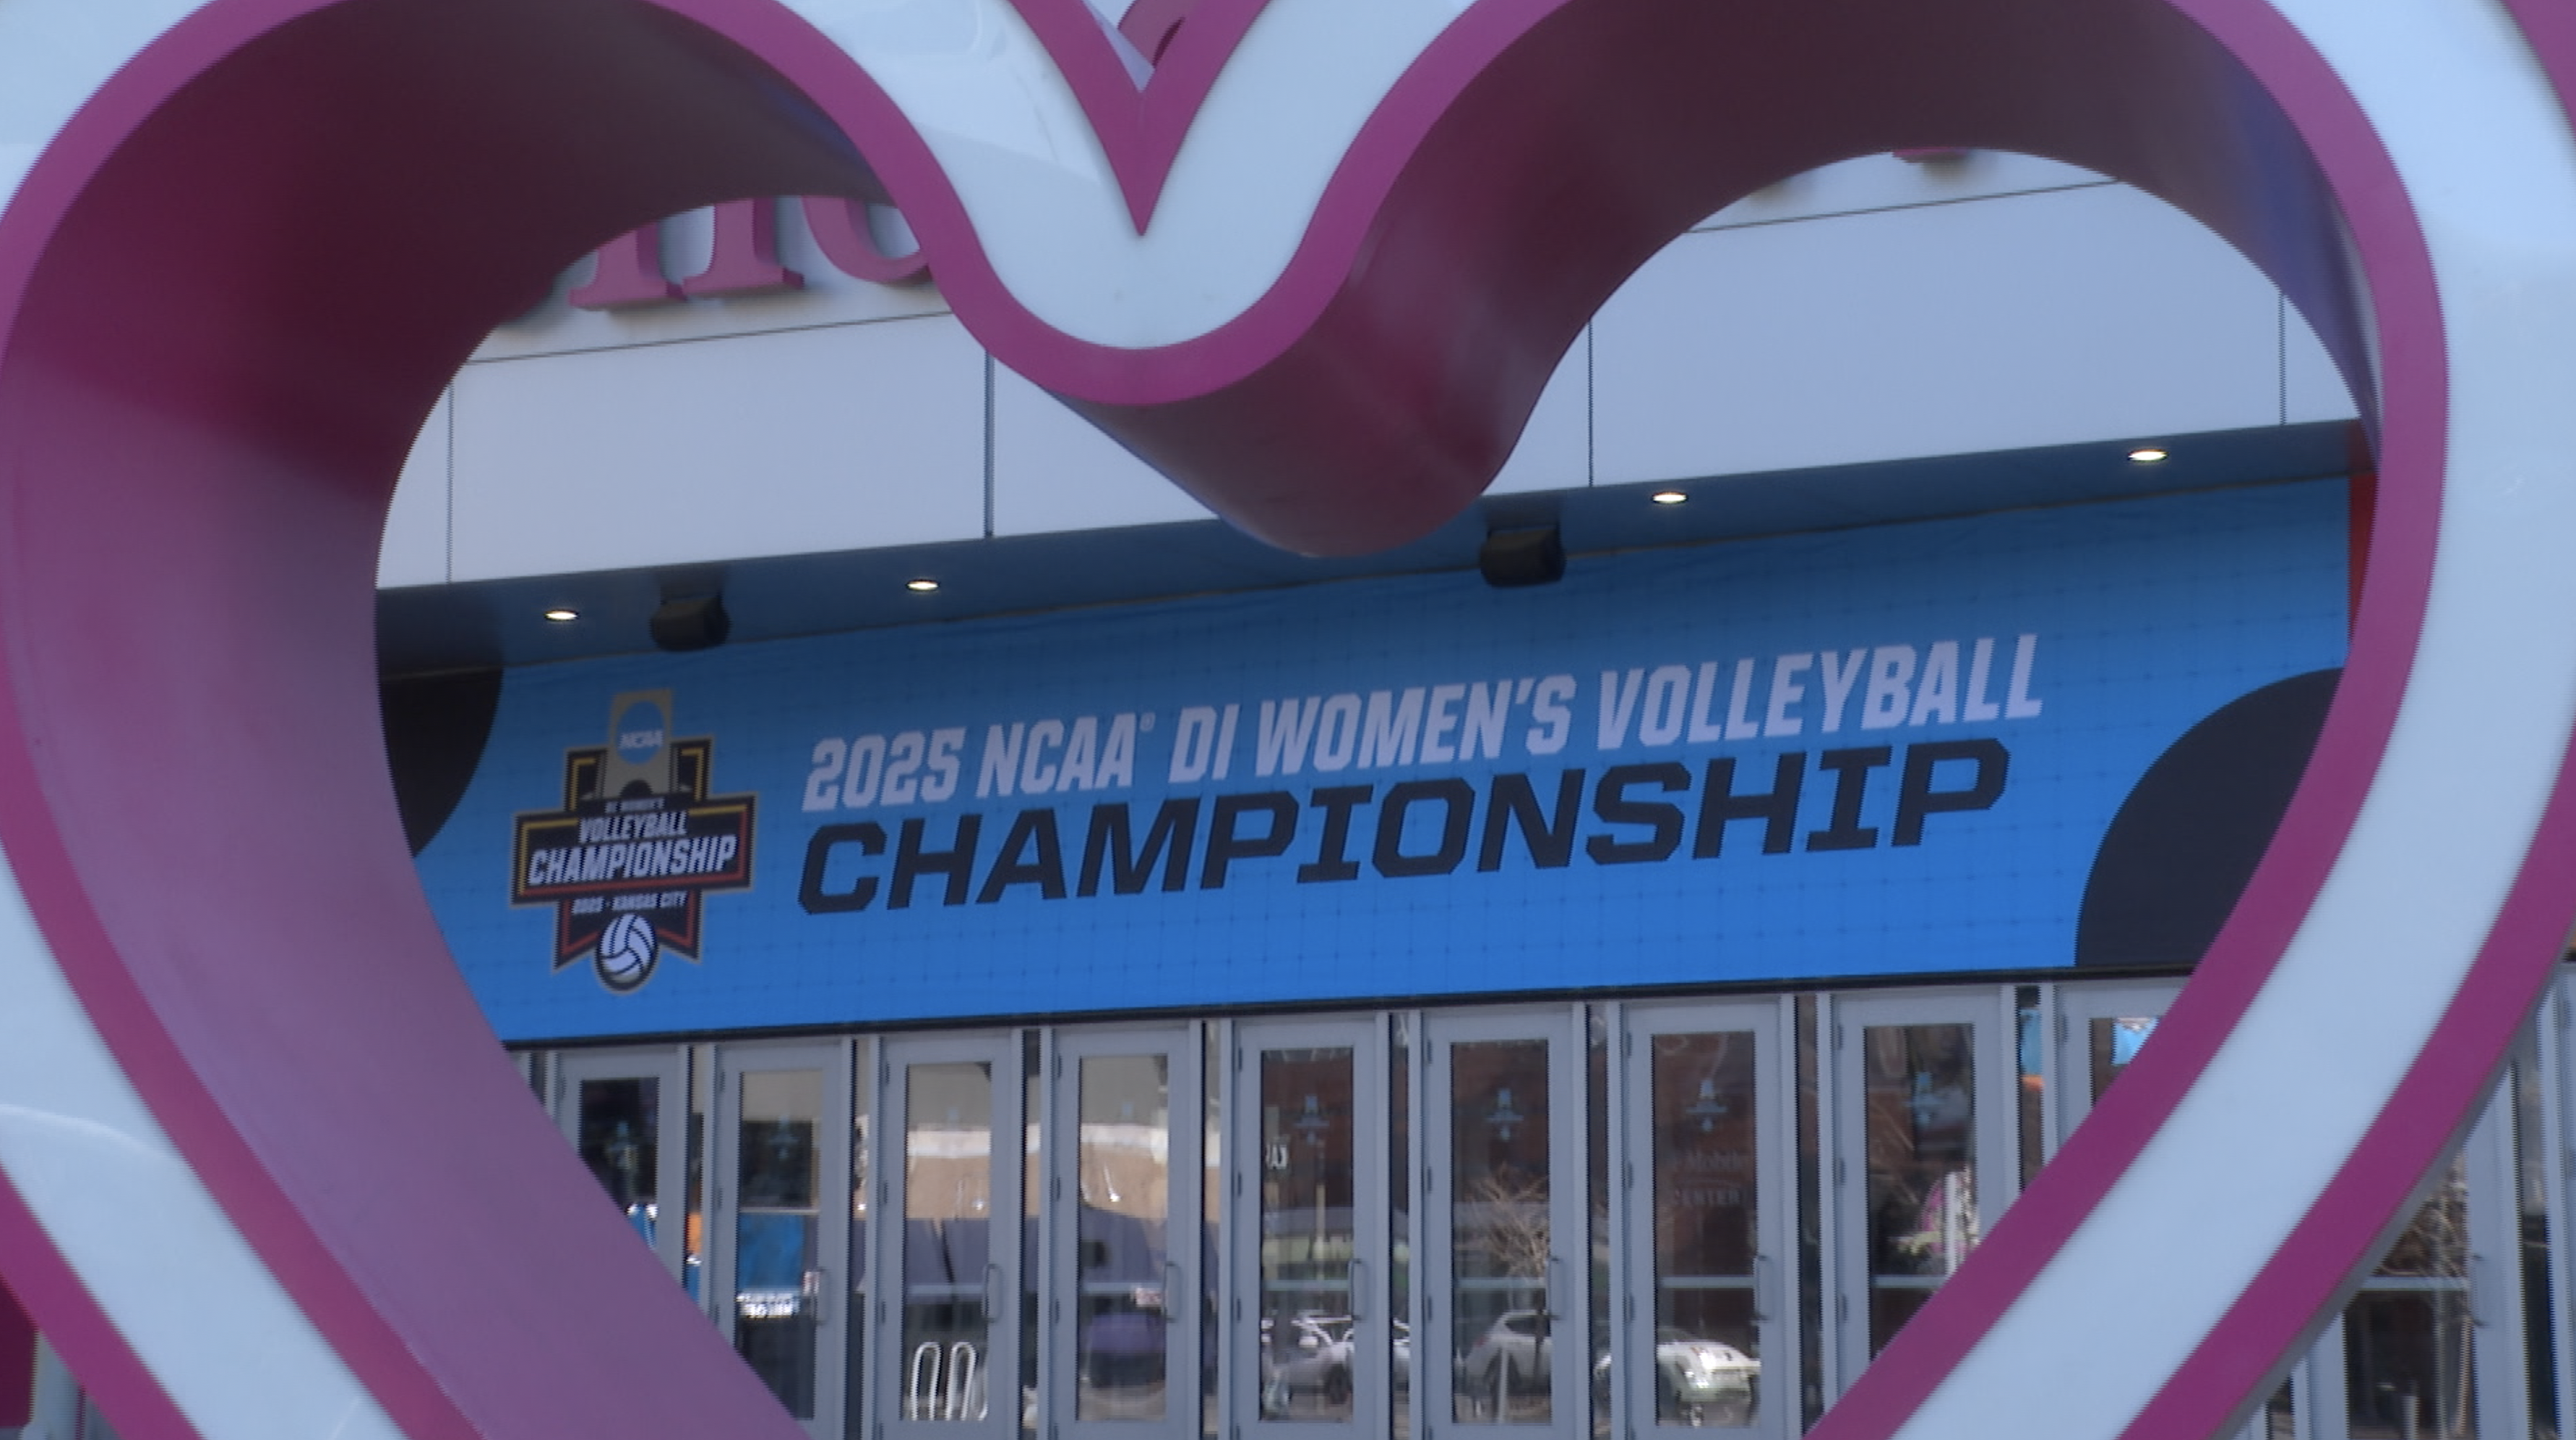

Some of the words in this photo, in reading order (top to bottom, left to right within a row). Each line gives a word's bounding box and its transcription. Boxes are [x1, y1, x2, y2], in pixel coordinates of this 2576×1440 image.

[801, 727, 966, 811] 2025
[1169, 703, 1240, 784] DI
[1255, 674, 1576, 777] WOMEN'S
[1597, 634, 2043, 750] VOLLEYBALL
[528, 834, 738, 886] CHAMPIONSHIP
[579, 810, 687, 844] VOLLEYBALL
[797, 737, 2011, 915] CHAMPIONSHIP
